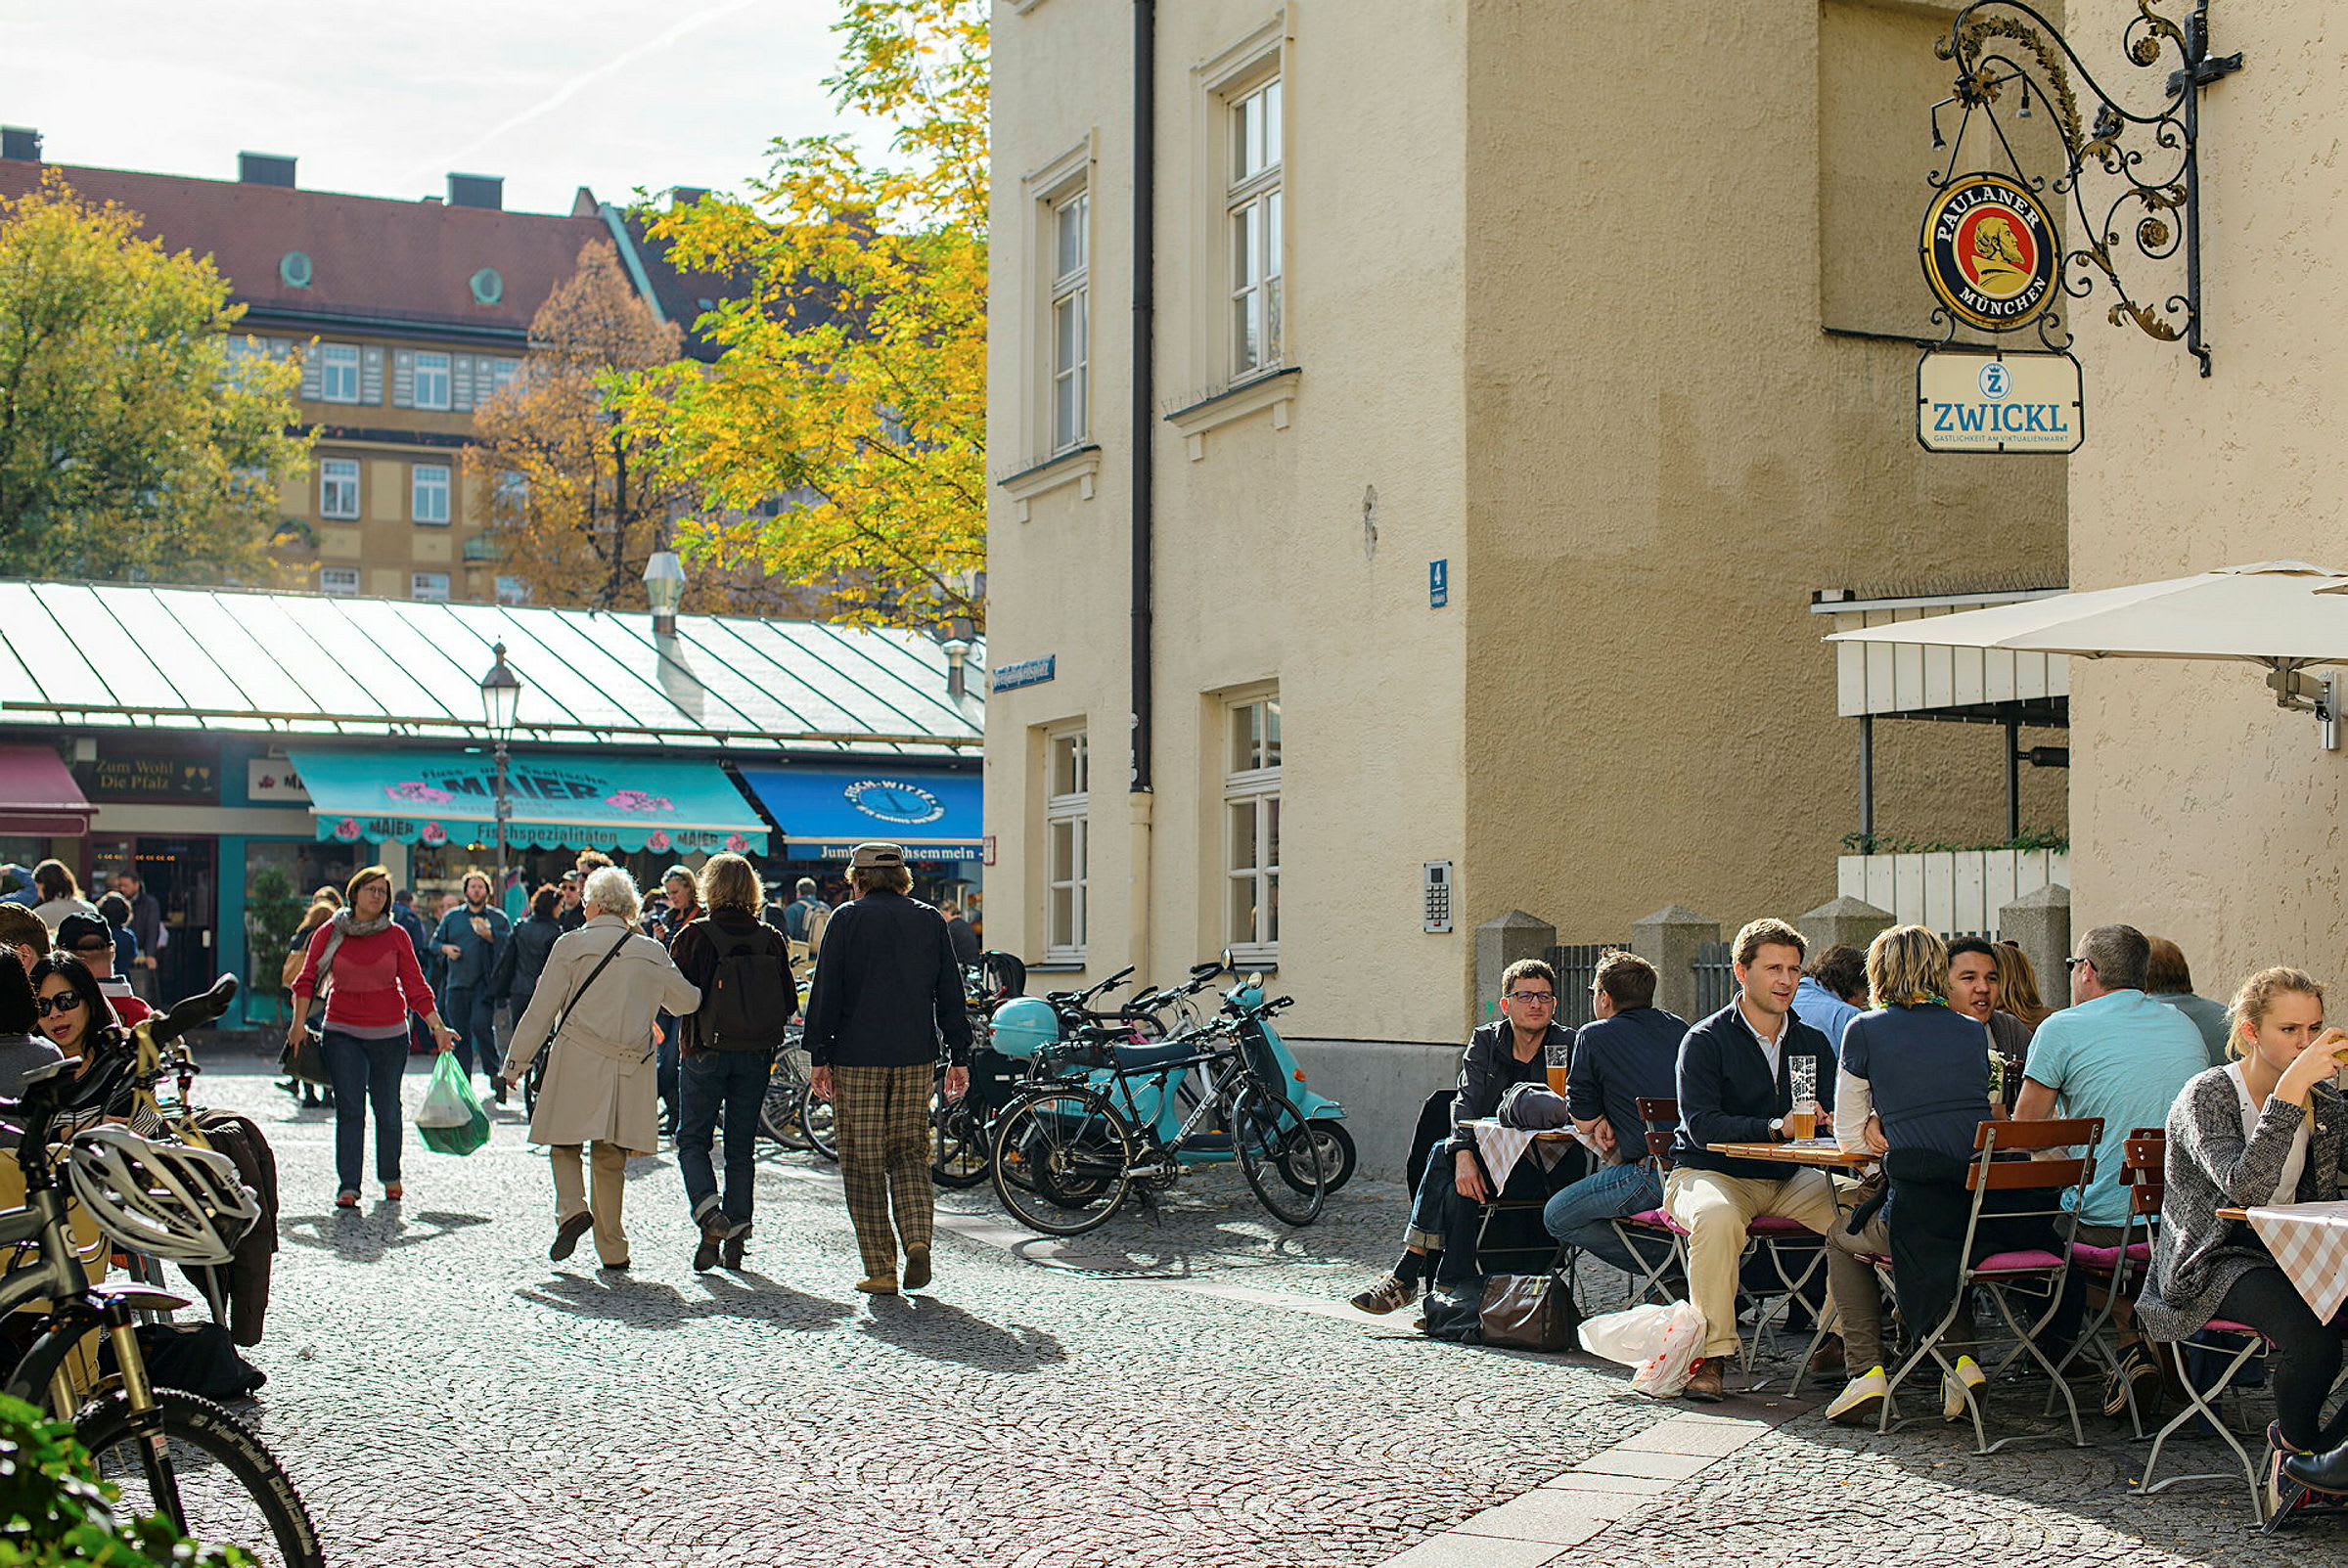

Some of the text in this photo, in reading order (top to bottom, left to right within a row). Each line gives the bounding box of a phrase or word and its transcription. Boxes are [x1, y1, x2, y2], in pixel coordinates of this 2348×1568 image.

[1936, 186, 2040, 243] PAULANER
[1958, 276, 2047, 315] MÜNCHEN
[1987, 374, 2003, 392] Z
[1933, 402, 2068, 431] ZWICKL
[96, 759, 173, 775] Zum Wohl
[100, 774, 170, 789] Die Pfalz
[442, 774, 600, 800] MAIER
[369, 819, 414, 836] MAIER
[677, 831, 719, 846] MAIER
